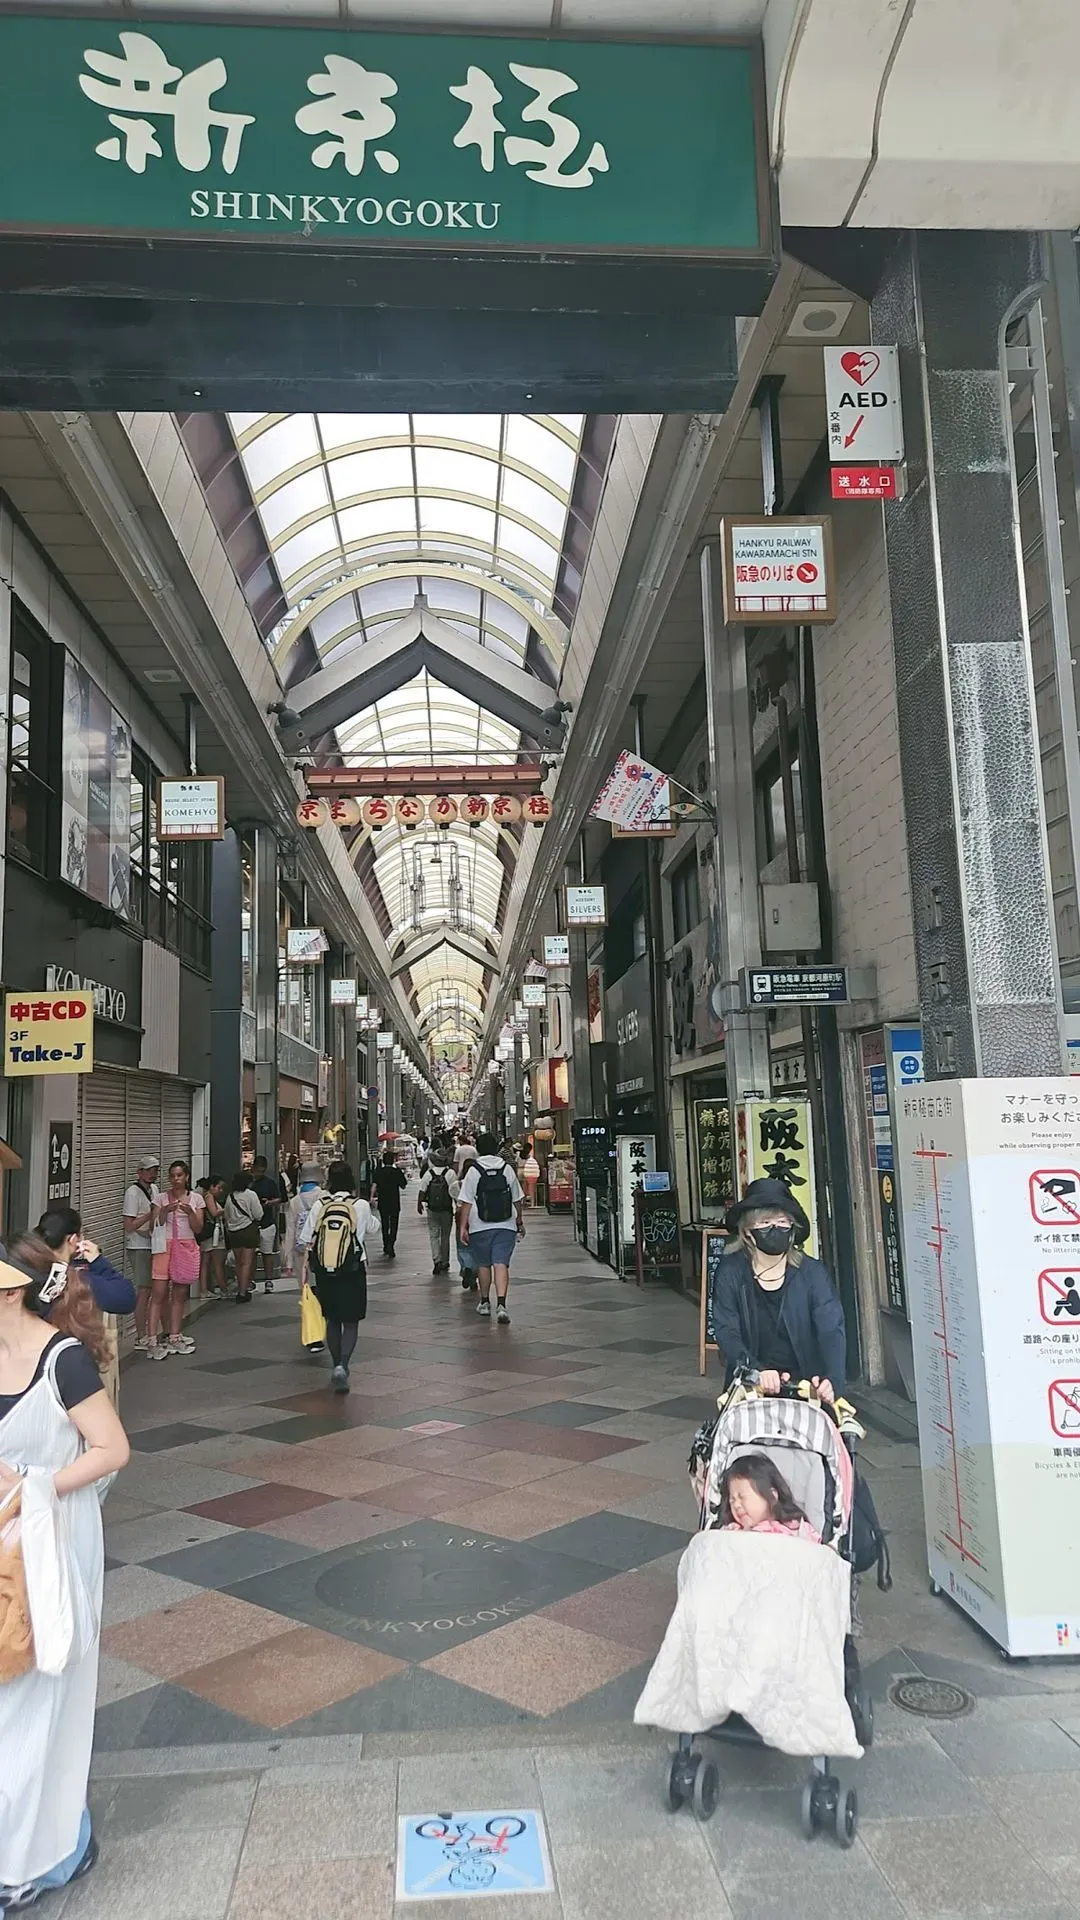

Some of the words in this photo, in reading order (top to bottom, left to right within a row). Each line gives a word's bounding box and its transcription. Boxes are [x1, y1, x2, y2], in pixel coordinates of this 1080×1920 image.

[79, 31, 609, 188] 新京極
[190, 190, 501, 229] SHINKYOGOKU
[839, 391, 888, 408] AED
[830, 411, 842, 445] 交番内
[838, 475, 891, 487] 送水口
[739, 539, 774, 548] HANKYU
[776, 538, 812, 547] RAILWAY
[735, 549, 800, 559] KAWARAMACHI
[802, 548, 818, 558] STN
[736, 564, 795, 583] 阪急のりば
[164, 808, 217, 817] KOMEHYO
[570, 904, 602, 914] SILVERS
[9, 1000, 87, 1022] 中古CD
[9, 1030, 29, 1041] 3F
[9, 1042, 87, 1063] Take-J
